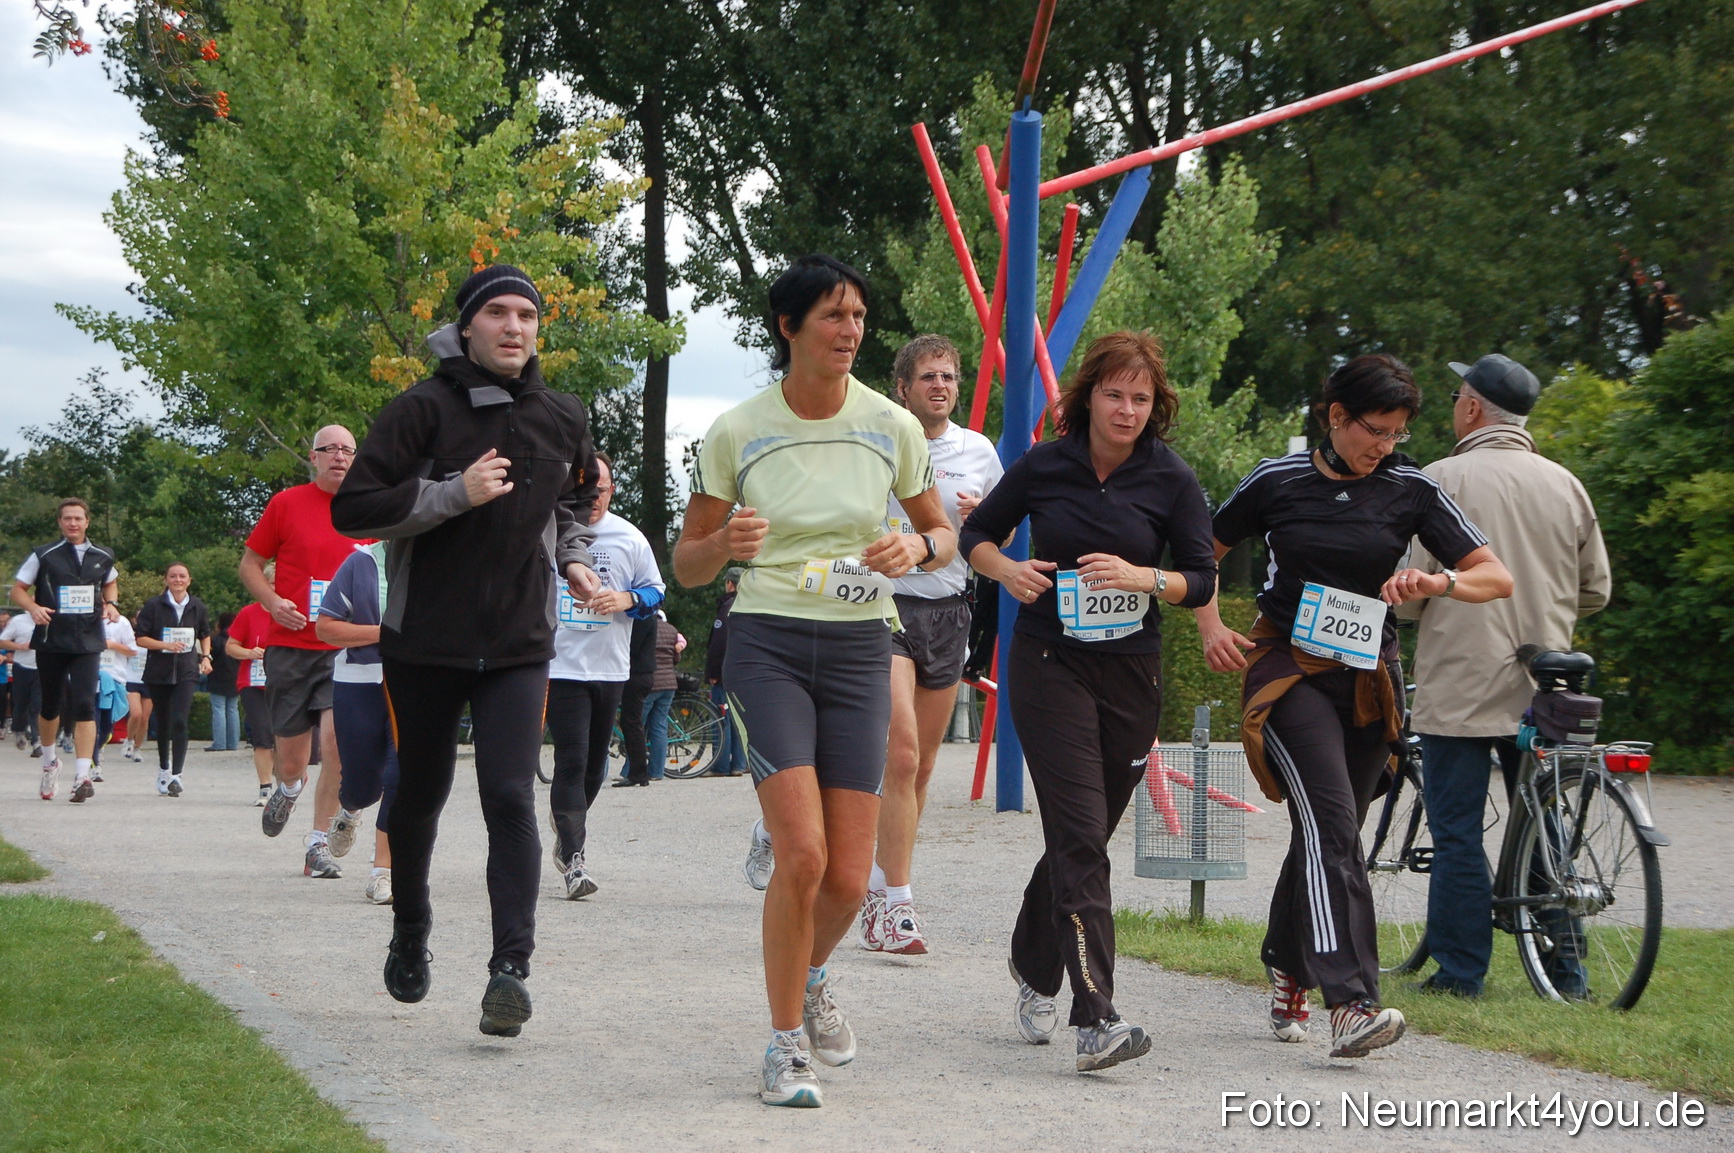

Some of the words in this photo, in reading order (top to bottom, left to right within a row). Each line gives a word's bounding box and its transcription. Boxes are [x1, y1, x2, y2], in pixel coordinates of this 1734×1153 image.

[805, 577, 813, 589] D
[71, 596, 91, 604] 2743
[835, 584, 879, 605] 924
[1063, 596, 1070, 606] D
[1085, 594, 1139, 615] 2028
[1326, 594, 1361, 614] Monika
[1303, 608, 1310, 618] D
[1320, 615, 1372, 643] 2029
